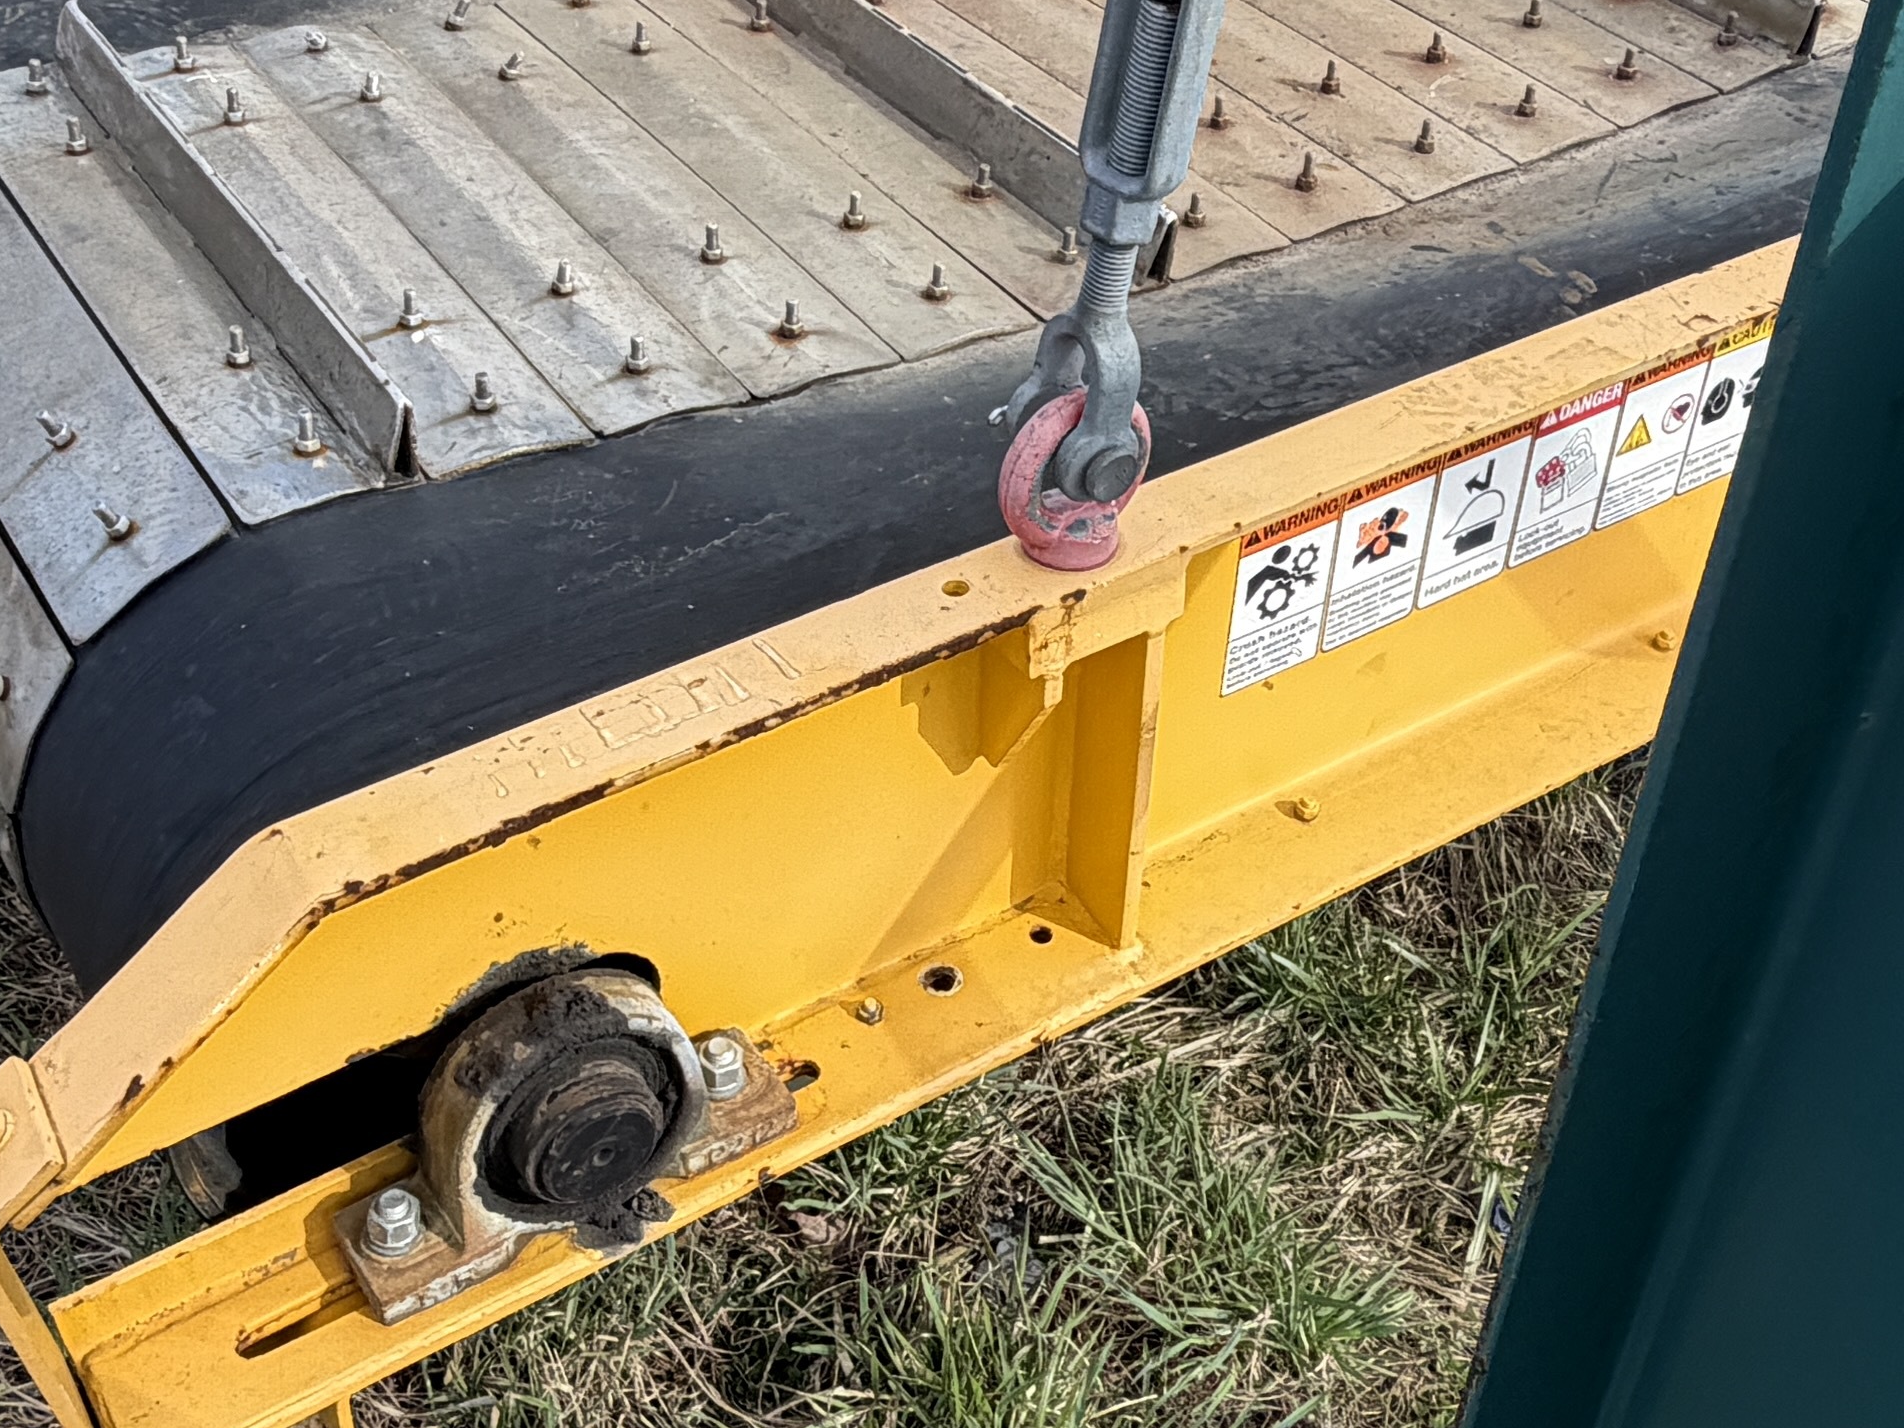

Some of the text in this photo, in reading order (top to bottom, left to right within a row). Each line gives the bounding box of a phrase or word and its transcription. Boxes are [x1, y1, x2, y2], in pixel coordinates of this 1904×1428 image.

[1559, 382, 1624, 420] DANGER
[1363, 456, 1438, 496] WARNING
[1263, 498, 1340, 539] WARNING
[1424, 560, 1499, 598] Hard hat area.
[1229, 635, 1266, 655] Crush
